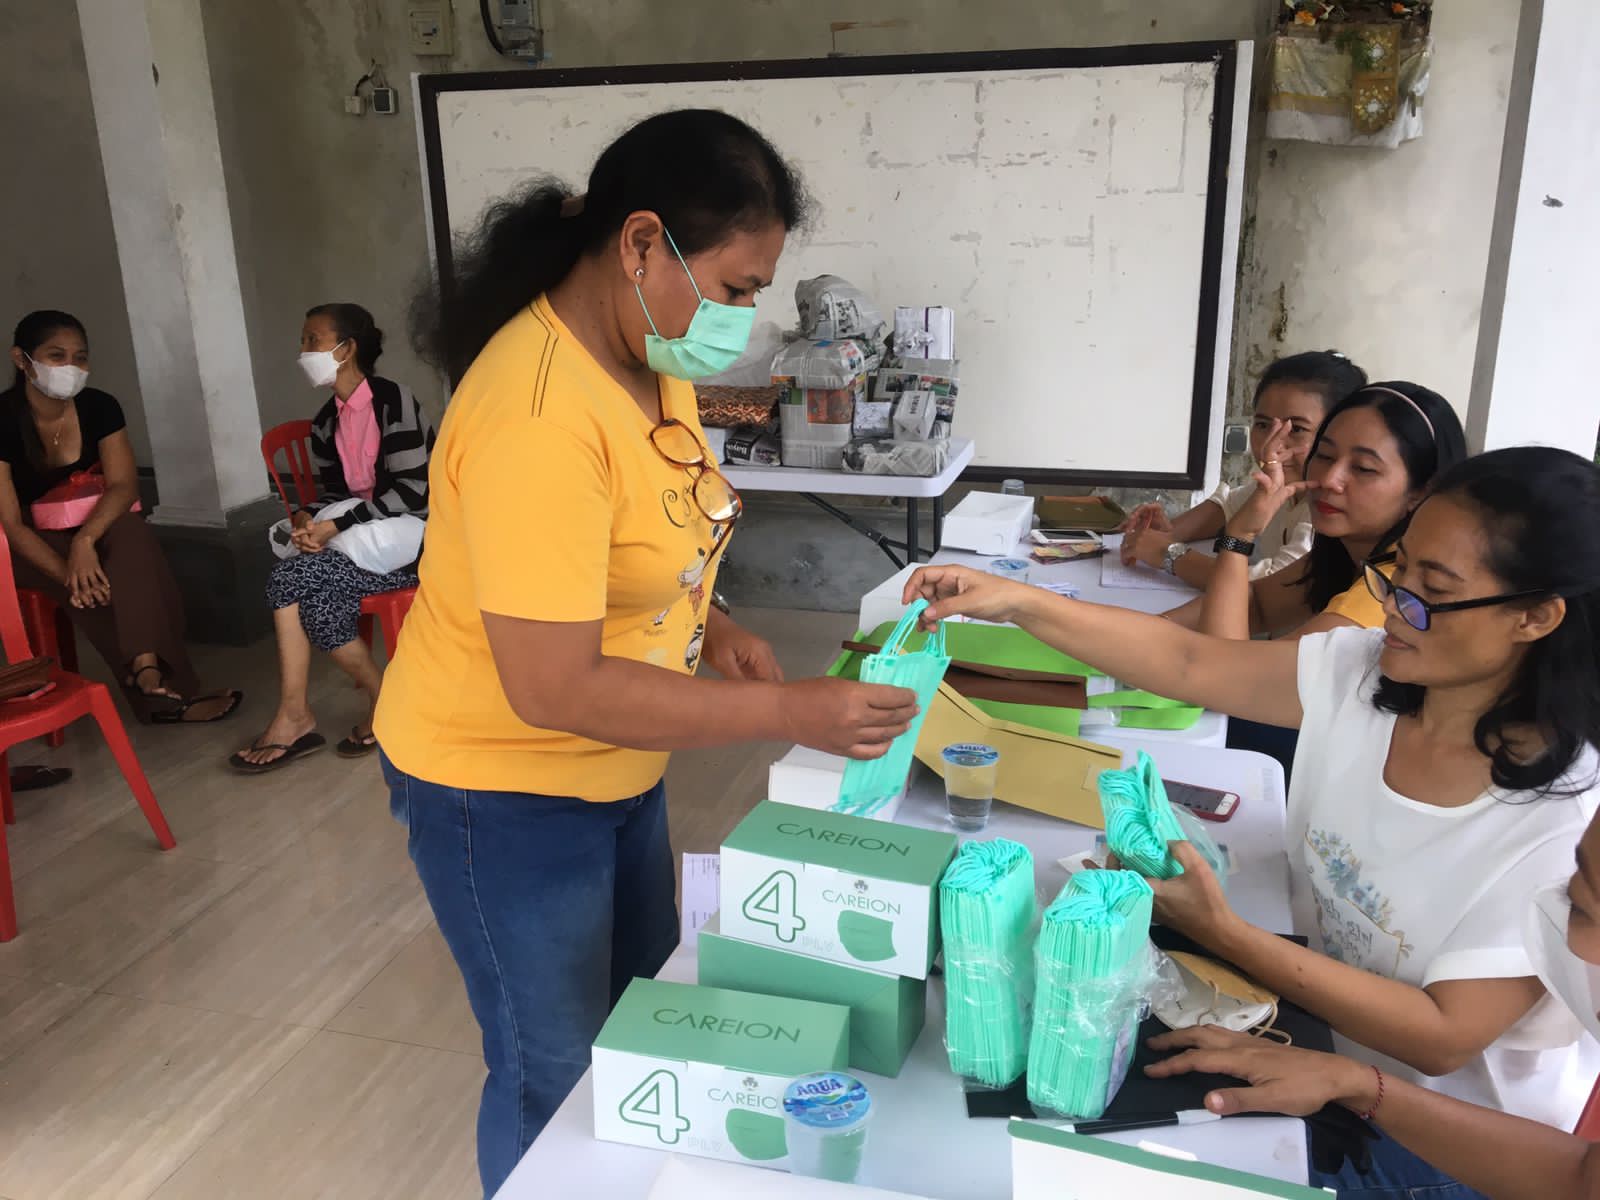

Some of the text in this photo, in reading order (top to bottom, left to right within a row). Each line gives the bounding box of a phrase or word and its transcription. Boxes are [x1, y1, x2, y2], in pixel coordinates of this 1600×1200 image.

[776, 823, 911, 856] CAREION
[742, 870, 806, 943] 4
[822, 889, 901, 915] CAREION
[653, 1008, 801, 1043] CAREION
[707, 1088, 781, 1110] CAREIO
[796, 1079, 843, 1097] AQUA
[618, 1069, 691, 1145] 4
